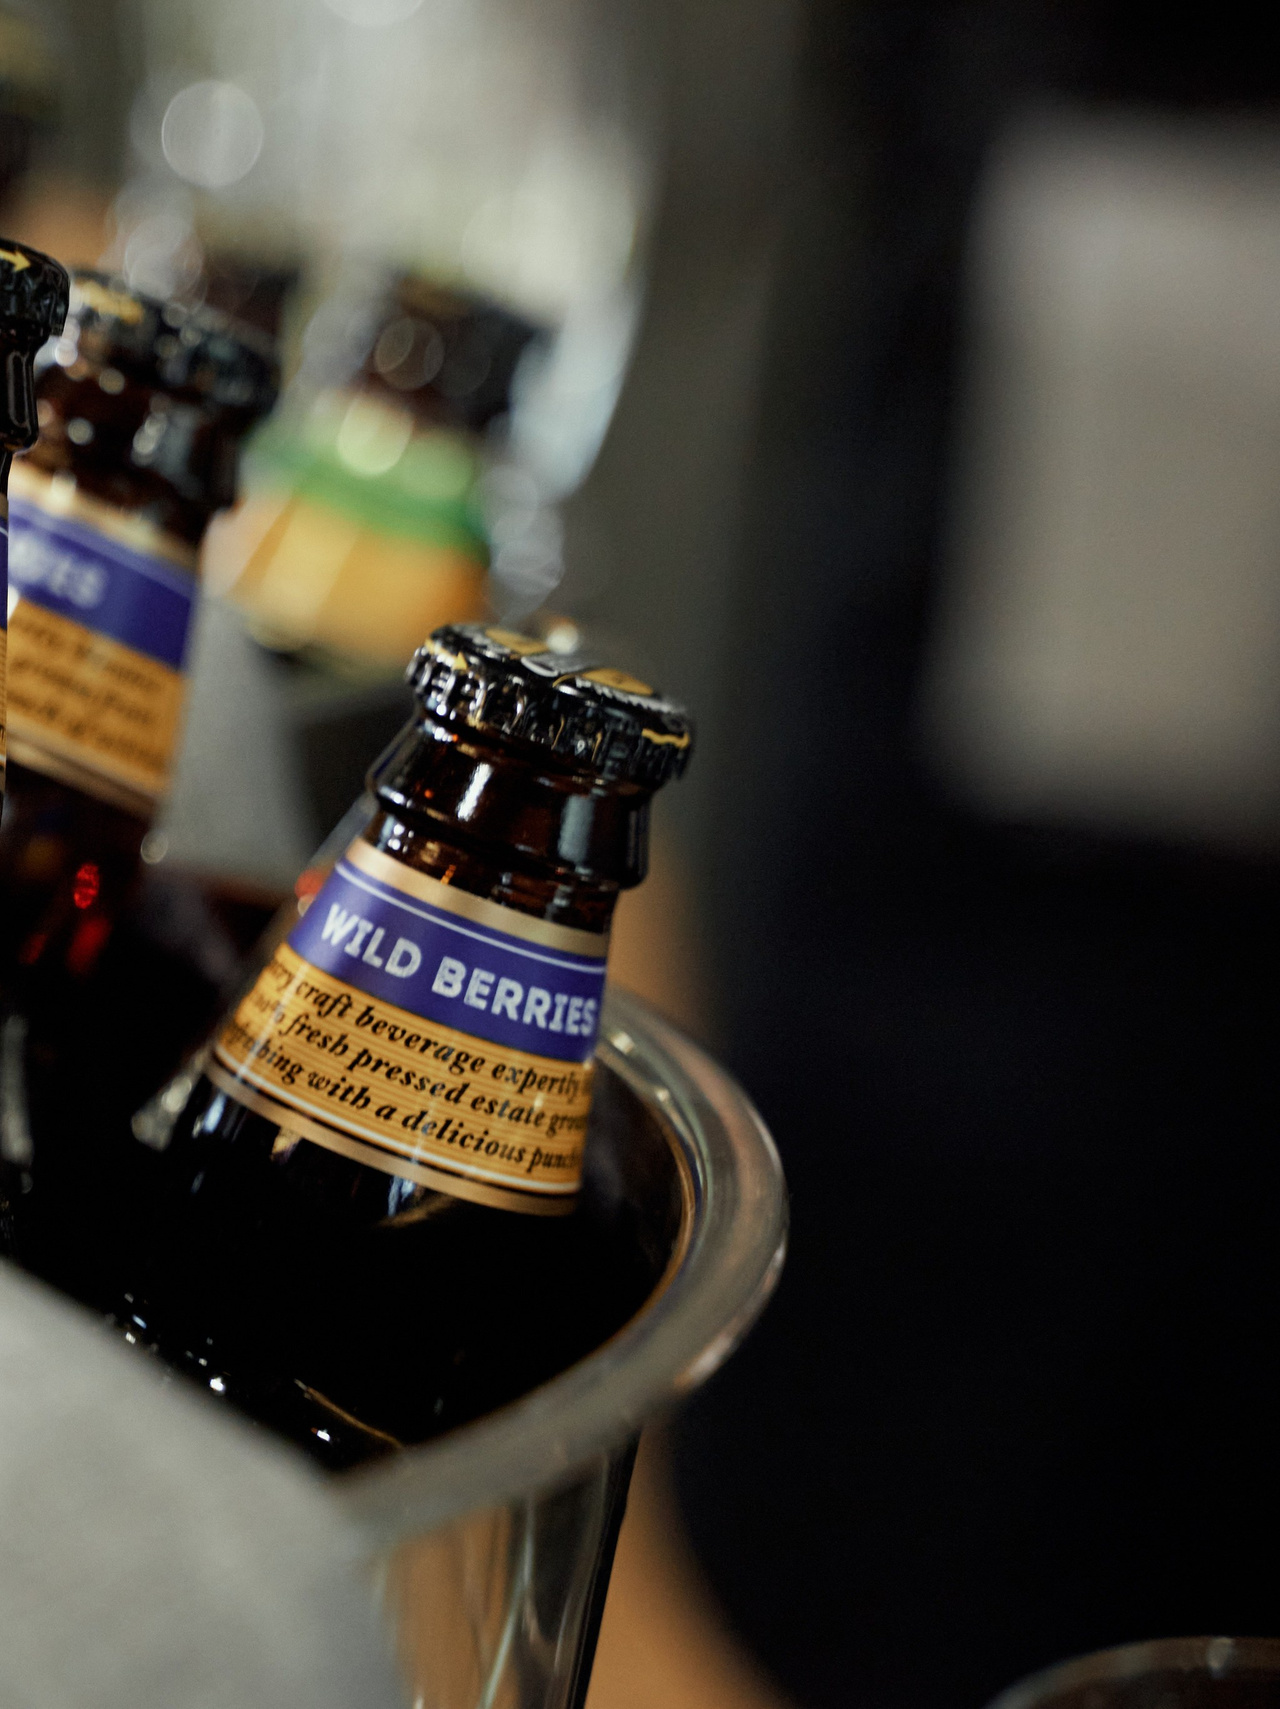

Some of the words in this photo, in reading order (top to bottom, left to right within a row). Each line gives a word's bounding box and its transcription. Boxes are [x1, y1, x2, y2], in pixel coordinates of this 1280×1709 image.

[321, 902, 422, 979] WILD
[431, 955, 598, 1037] BERRIES
[277, 1012, 350, 1057] fresh
[346, 1047, 471, 1105] pressed
[470, 1094, 547, 1127] estate
[295, 981, 353, 1019] craft
[355, 1004, 487, 1076] beverage
[307, 1070, 372, 1110] with
[374, 1103, 398, 1121] a
[401, 1110, 527, 1164] delicious
